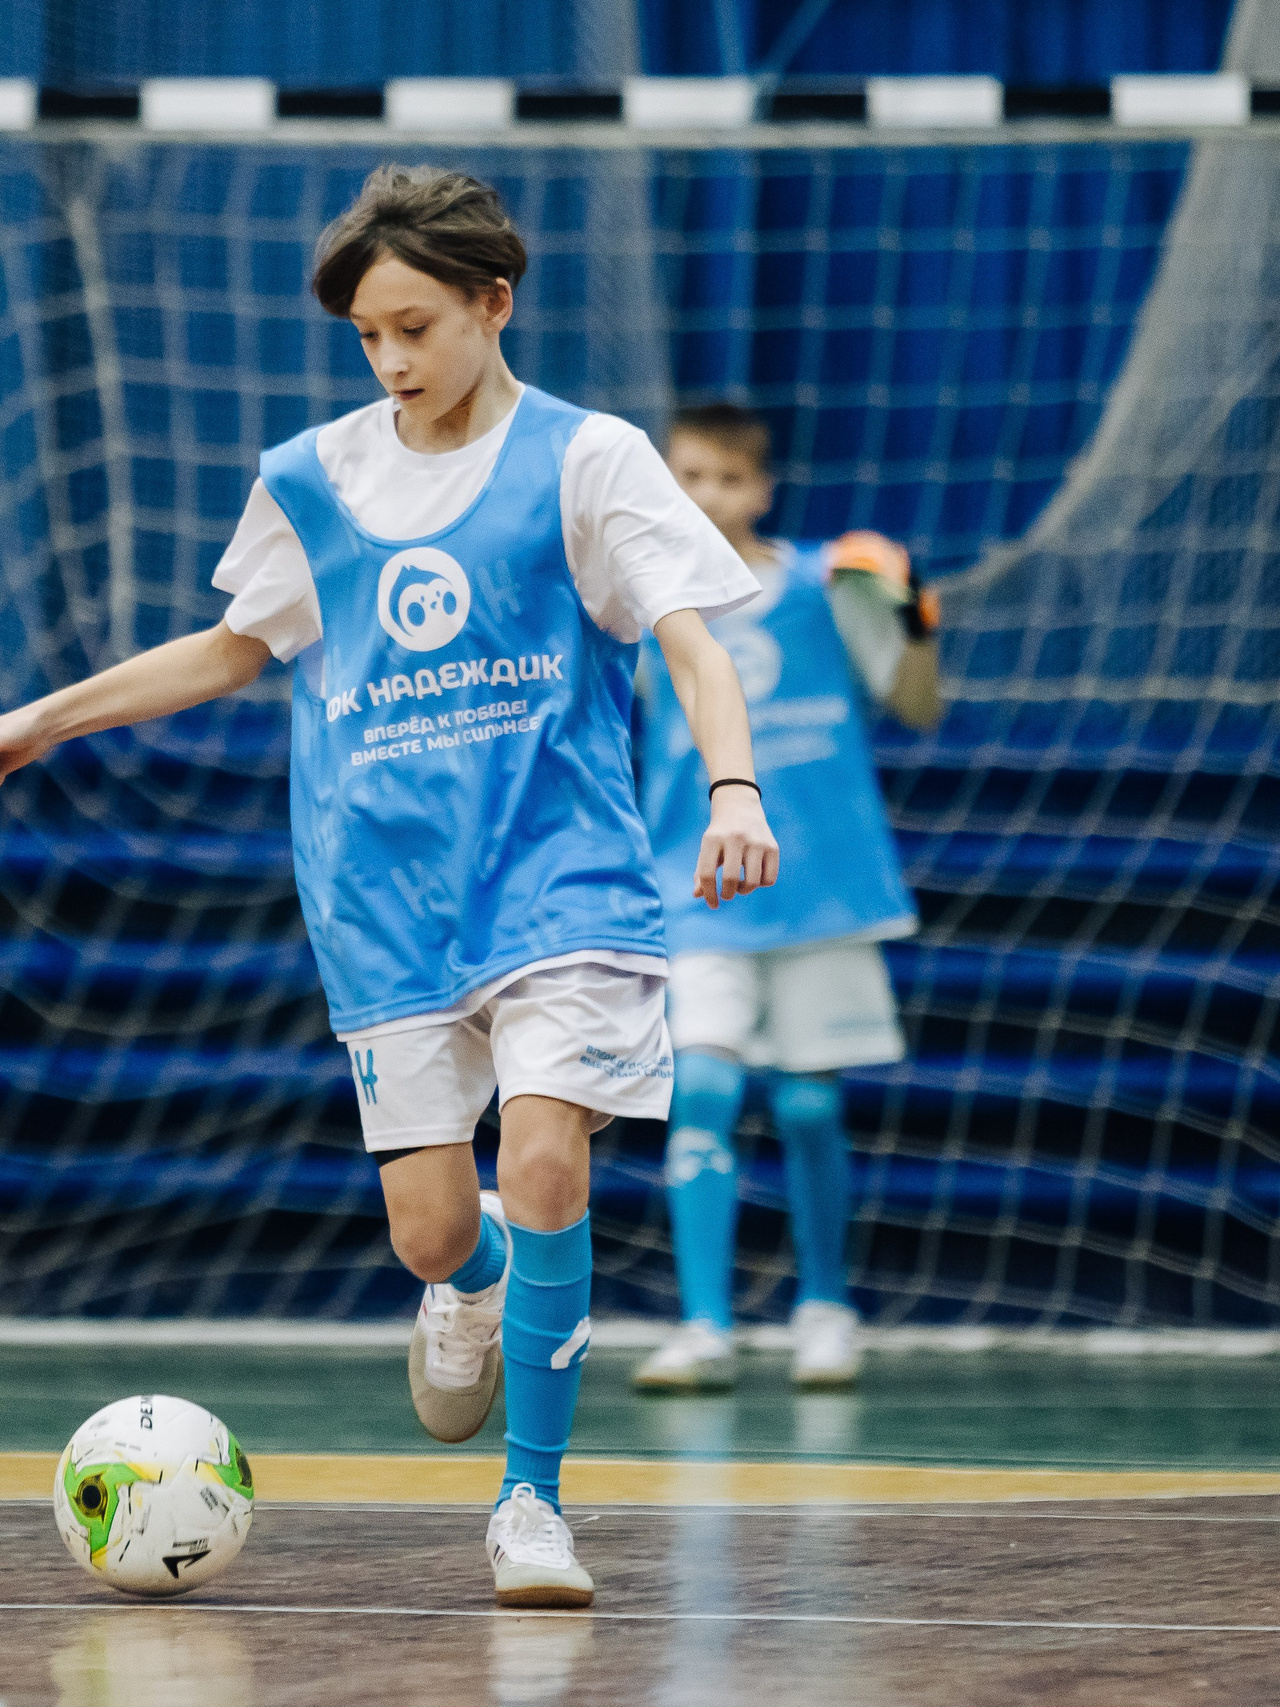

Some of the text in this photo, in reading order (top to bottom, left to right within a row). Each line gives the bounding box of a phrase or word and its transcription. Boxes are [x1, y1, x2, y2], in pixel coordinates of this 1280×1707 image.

[367, 655, 563, 706] НАДЕЖДИК
[351, 715, 542, 767] ВМЕСТЕ МЫ СИЛЬНЕЕ
[363, 699, 528, 744] ВПЕРЁД К ПОБЕДЕ!
